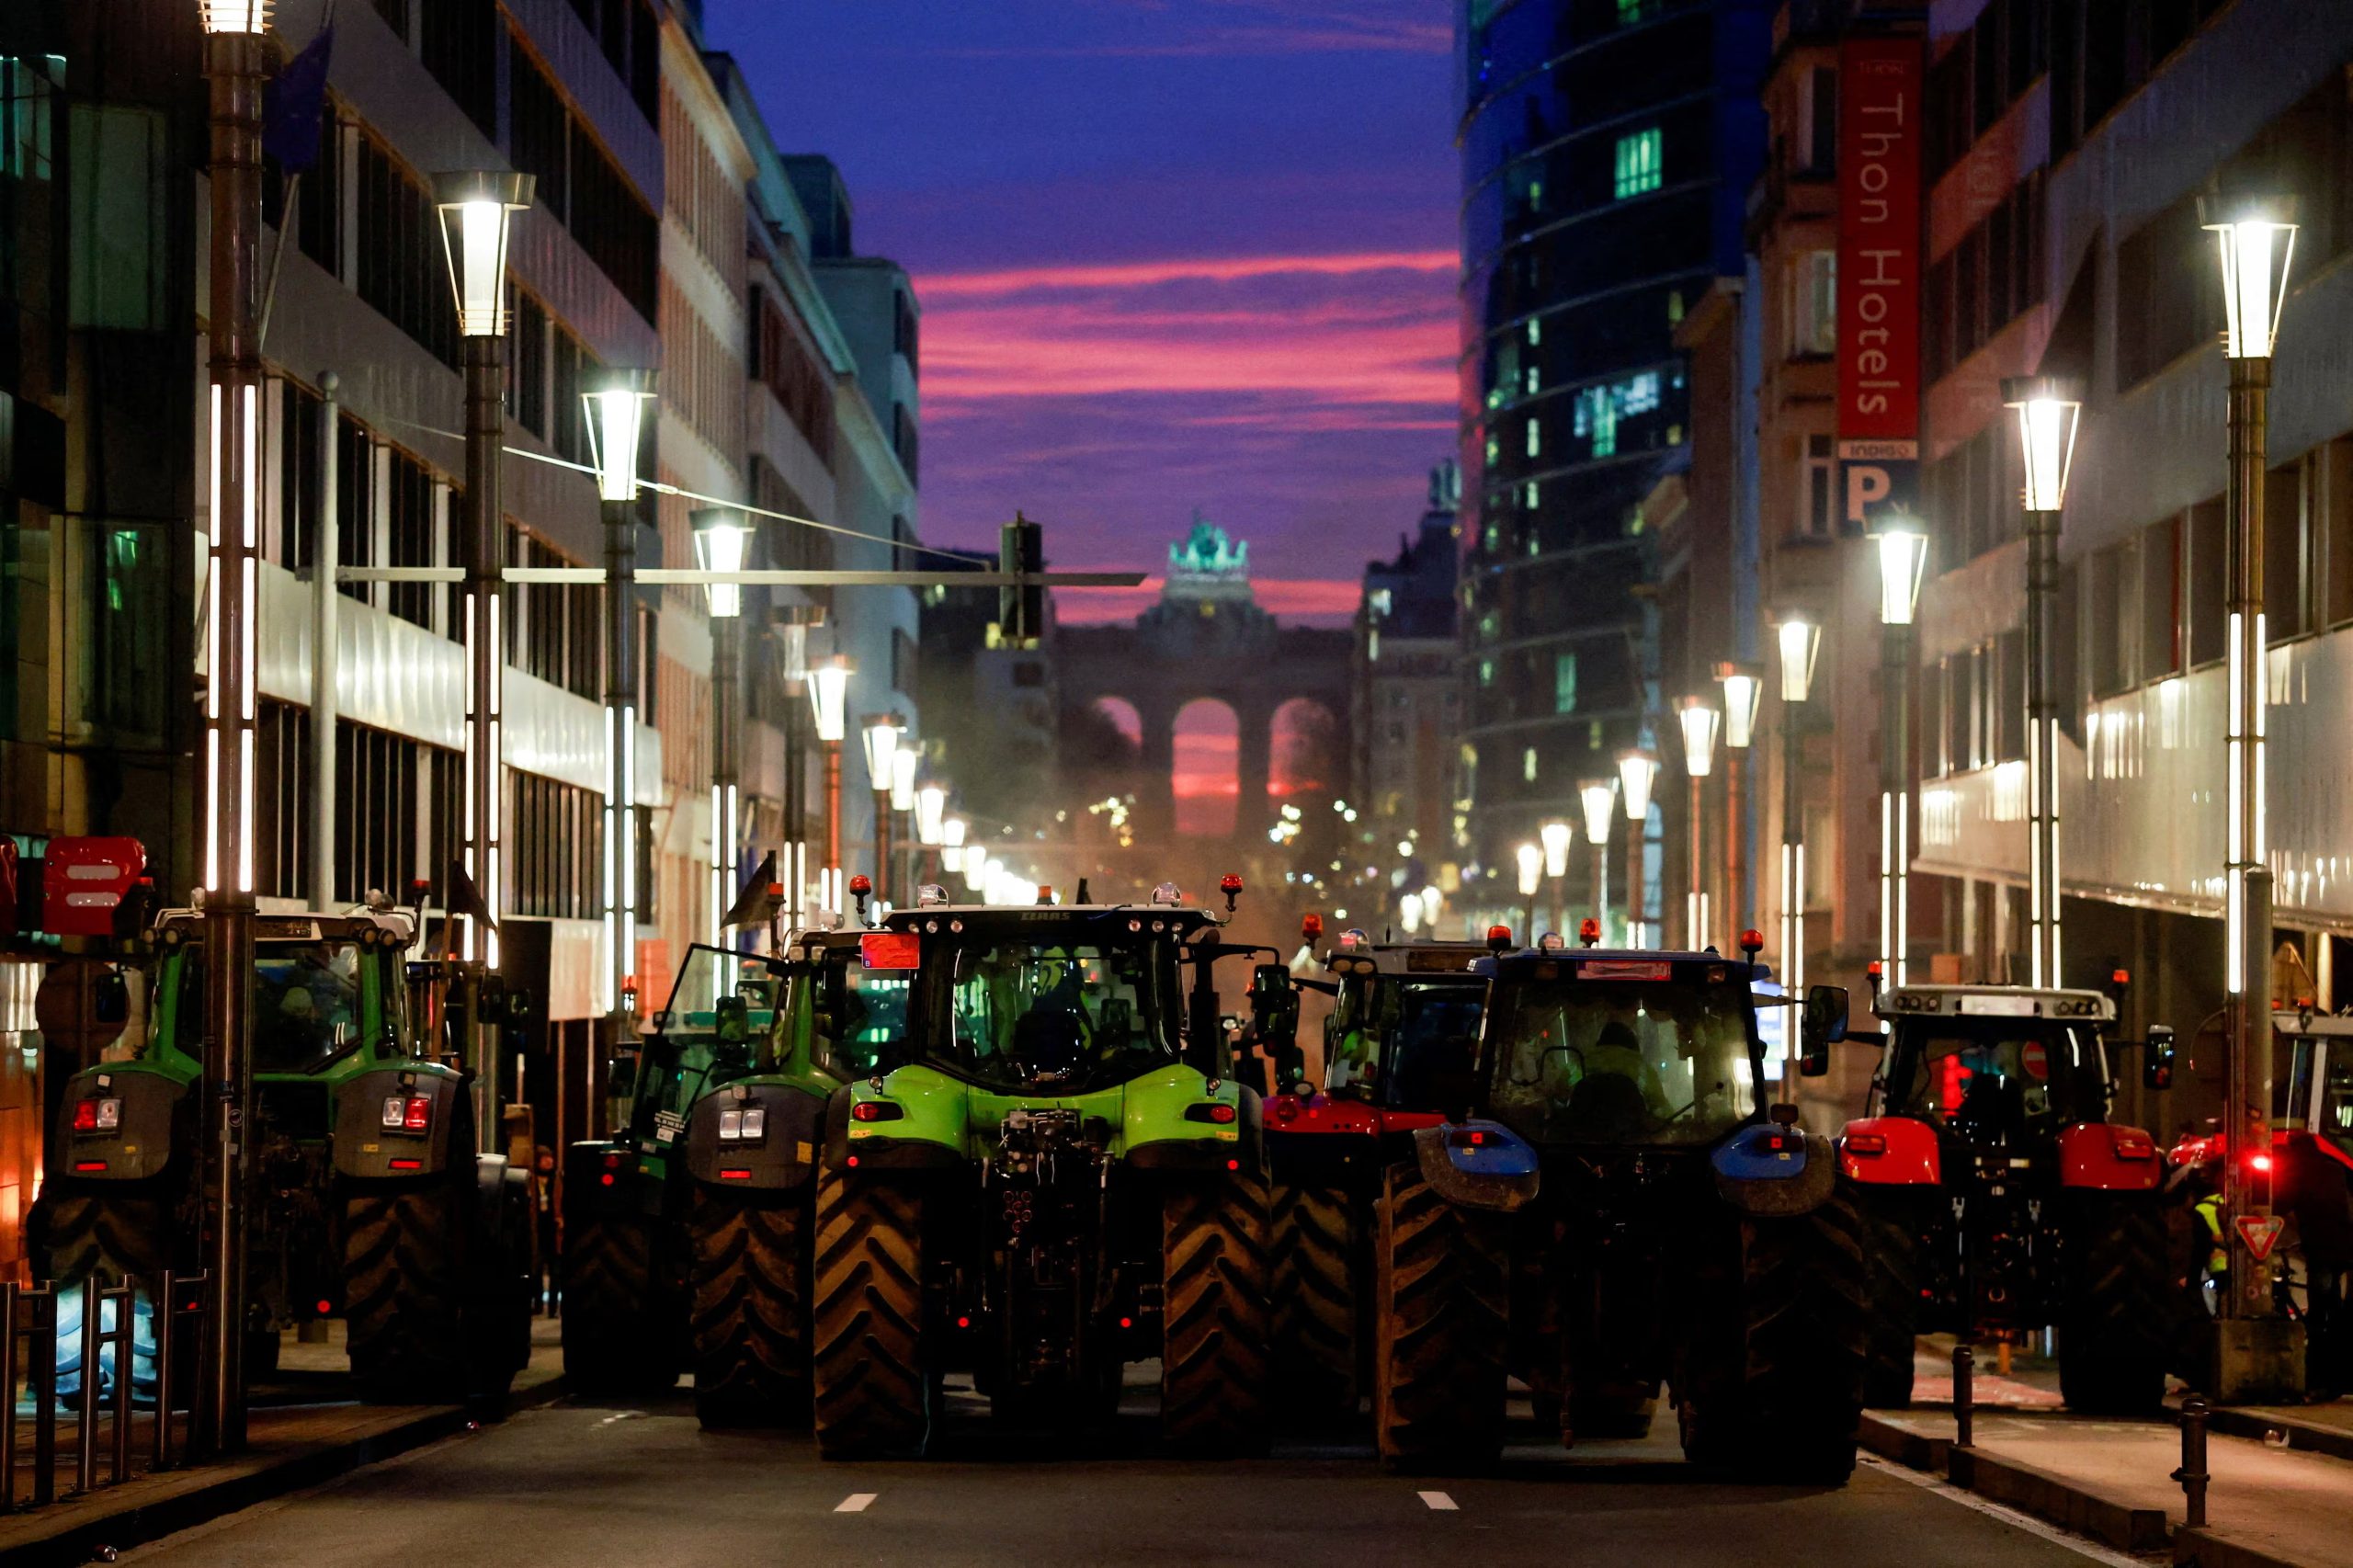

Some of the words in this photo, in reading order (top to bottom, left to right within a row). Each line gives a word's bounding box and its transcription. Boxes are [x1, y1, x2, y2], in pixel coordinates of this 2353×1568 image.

[1859, 92, 1903, 222] Thon
[1858, 250, 1901, 414] Hotels
[1847, 466, 1892, 521] P
